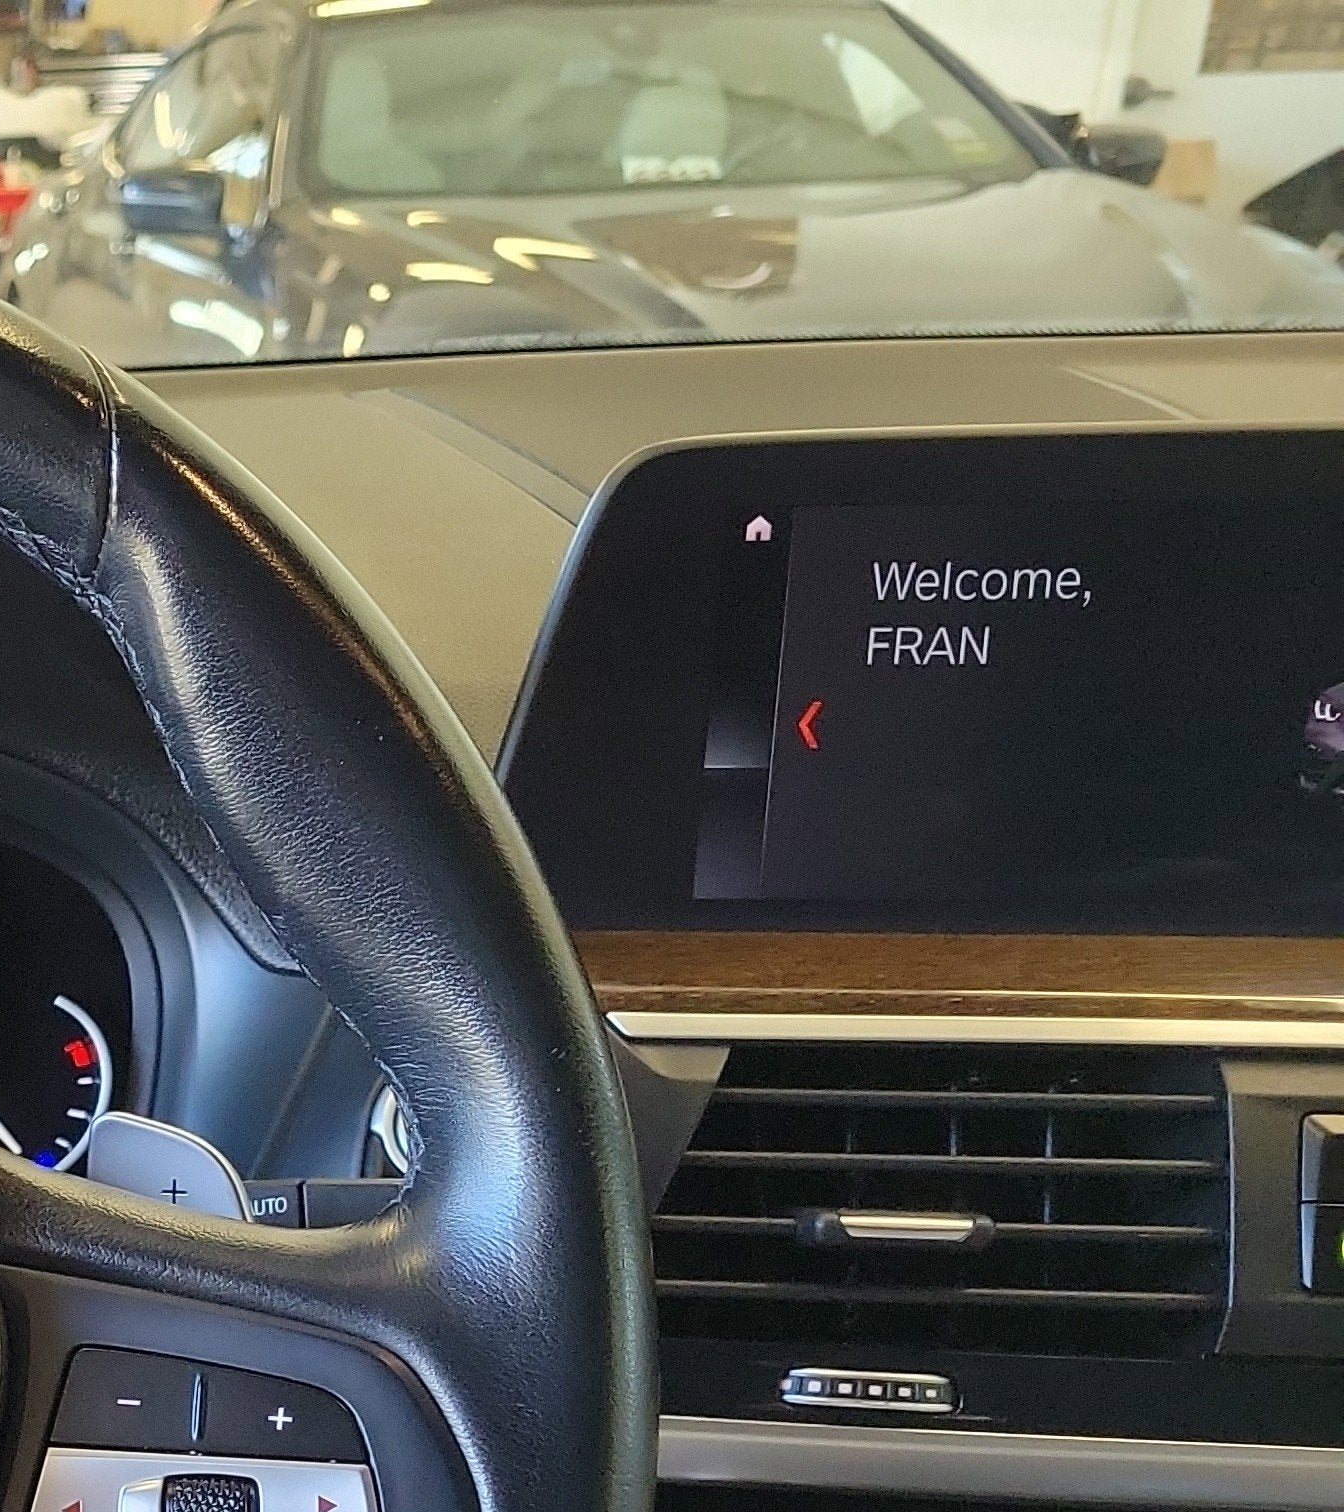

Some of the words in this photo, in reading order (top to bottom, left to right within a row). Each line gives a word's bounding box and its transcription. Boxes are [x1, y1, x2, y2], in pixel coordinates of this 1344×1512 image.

[872, 560, 1094, 606] Welcome,
[865, 625, 992, 667] FRAN
[251, 1196, 288, 1217] UTO
